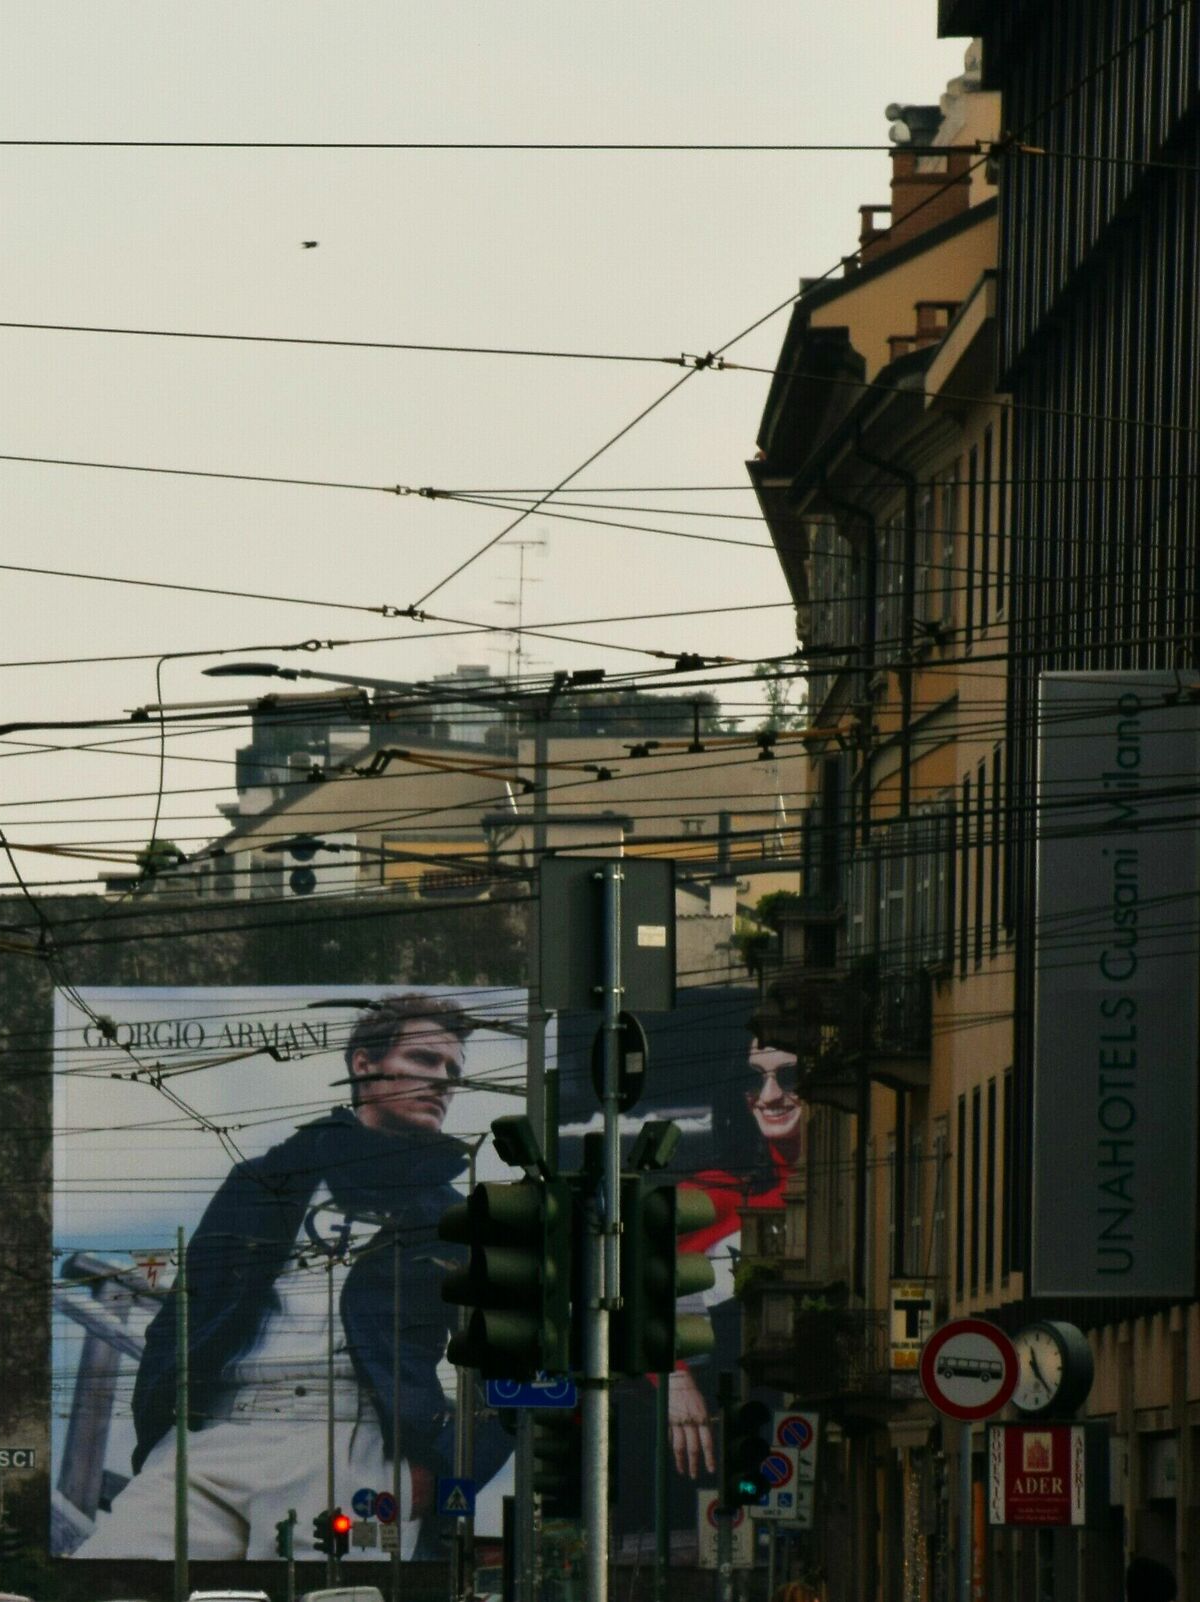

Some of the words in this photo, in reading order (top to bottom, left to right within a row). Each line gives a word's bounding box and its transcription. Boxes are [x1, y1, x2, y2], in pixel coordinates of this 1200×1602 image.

[1100, 849, 1138, 981] Cusani
[218, 1021, 328, 1049] ARMANI
[1097, 998, 1137, 1275] UNAHOTELS
[1012, 1477, 1064, 1495] ADER
